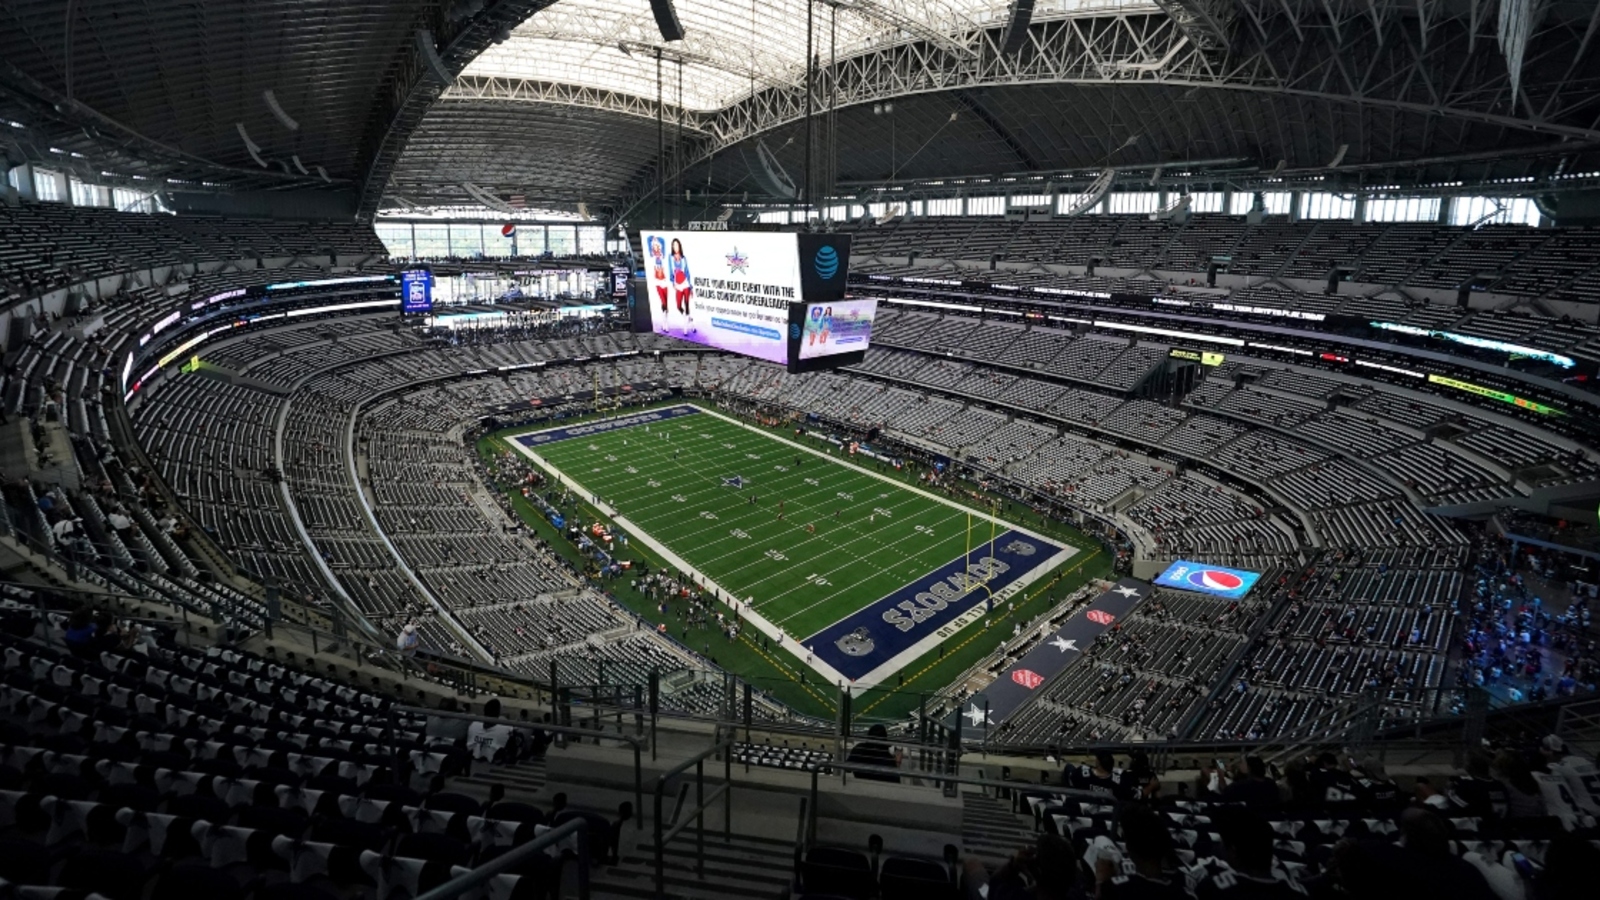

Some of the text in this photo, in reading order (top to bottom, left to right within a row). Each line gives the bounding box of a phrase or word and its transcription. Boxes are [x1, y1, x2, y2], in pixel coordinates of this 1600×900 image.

[727, 280, 741, 292] NEXT
[742, 282, 761, 294] EVENT
[763, 284, 781, 297] WITH
[781, 286, 795, 298] THE
[717, 291, 745, 304] COWBOYS
[805, 573, 828, 586] 10
[882, 556, 1011, 633] COWBOYS
[967, 604, 986, 617] ALL
[953, 617, 969, 629] OF
[936, 625, 953, 638] US
